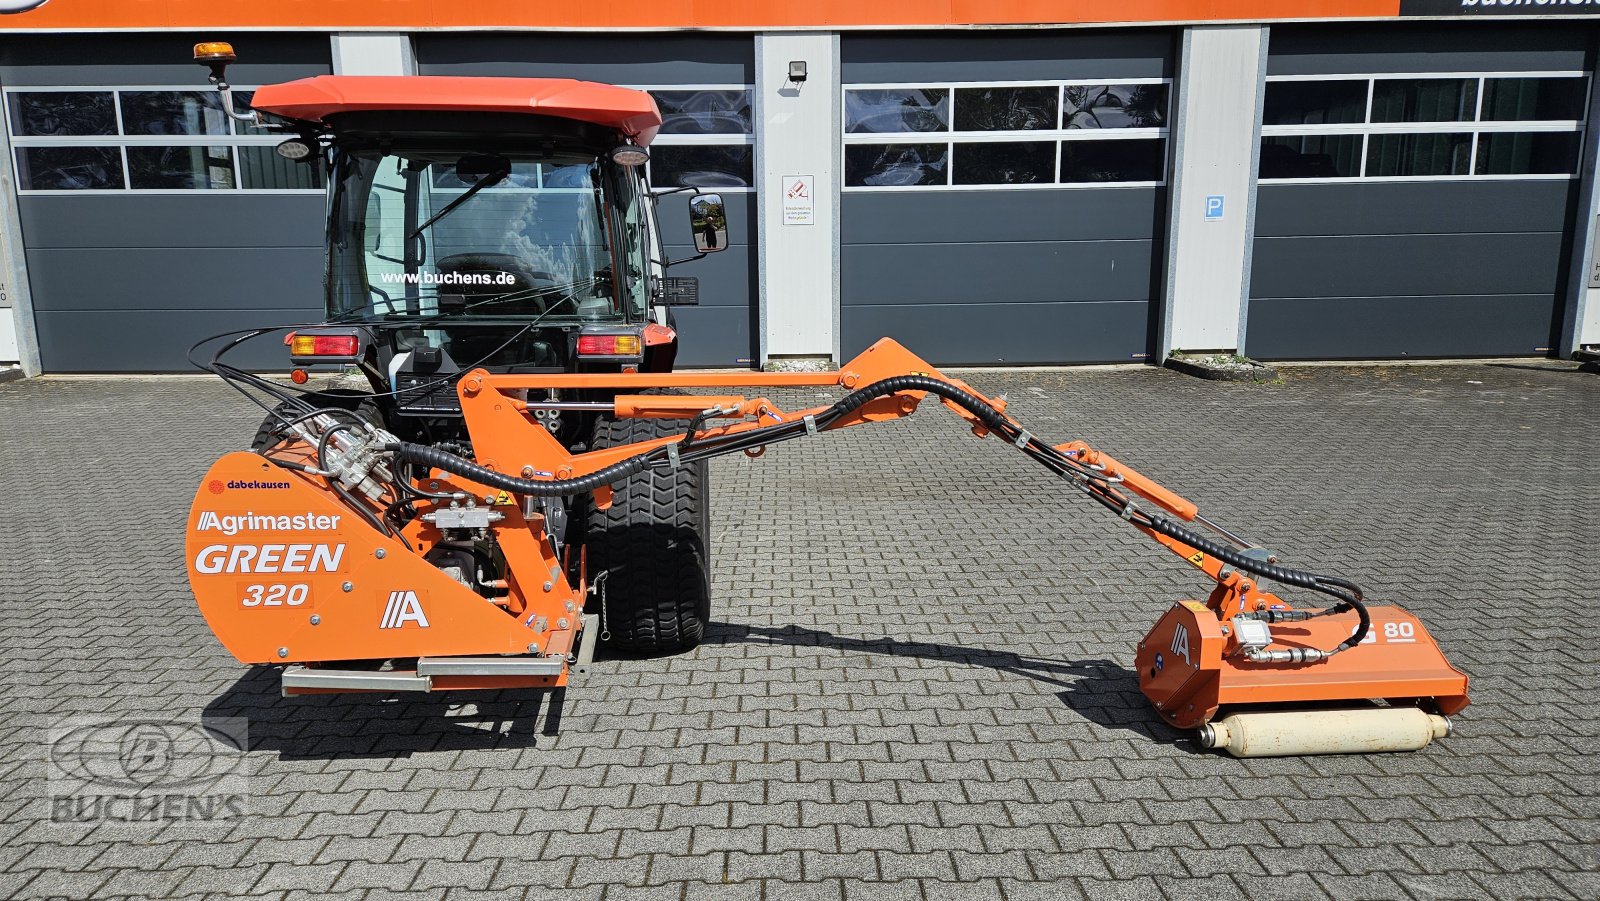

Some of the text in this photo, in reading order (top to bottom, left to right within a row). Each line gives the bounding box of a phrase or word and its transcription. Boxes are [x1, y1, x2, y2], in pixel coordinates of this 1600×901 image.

[1208, 198, 1221, 215] P
[381, 271, 515, 285] www.buchens.de
[227, 480, 290, 489] dabekausen
[197, 511, 341, 536] Agrimaster
[194, 543, 347, 574] GREEN
[242, 583, 309, 608] 320
[1384, 622, 1414, 638] 80
